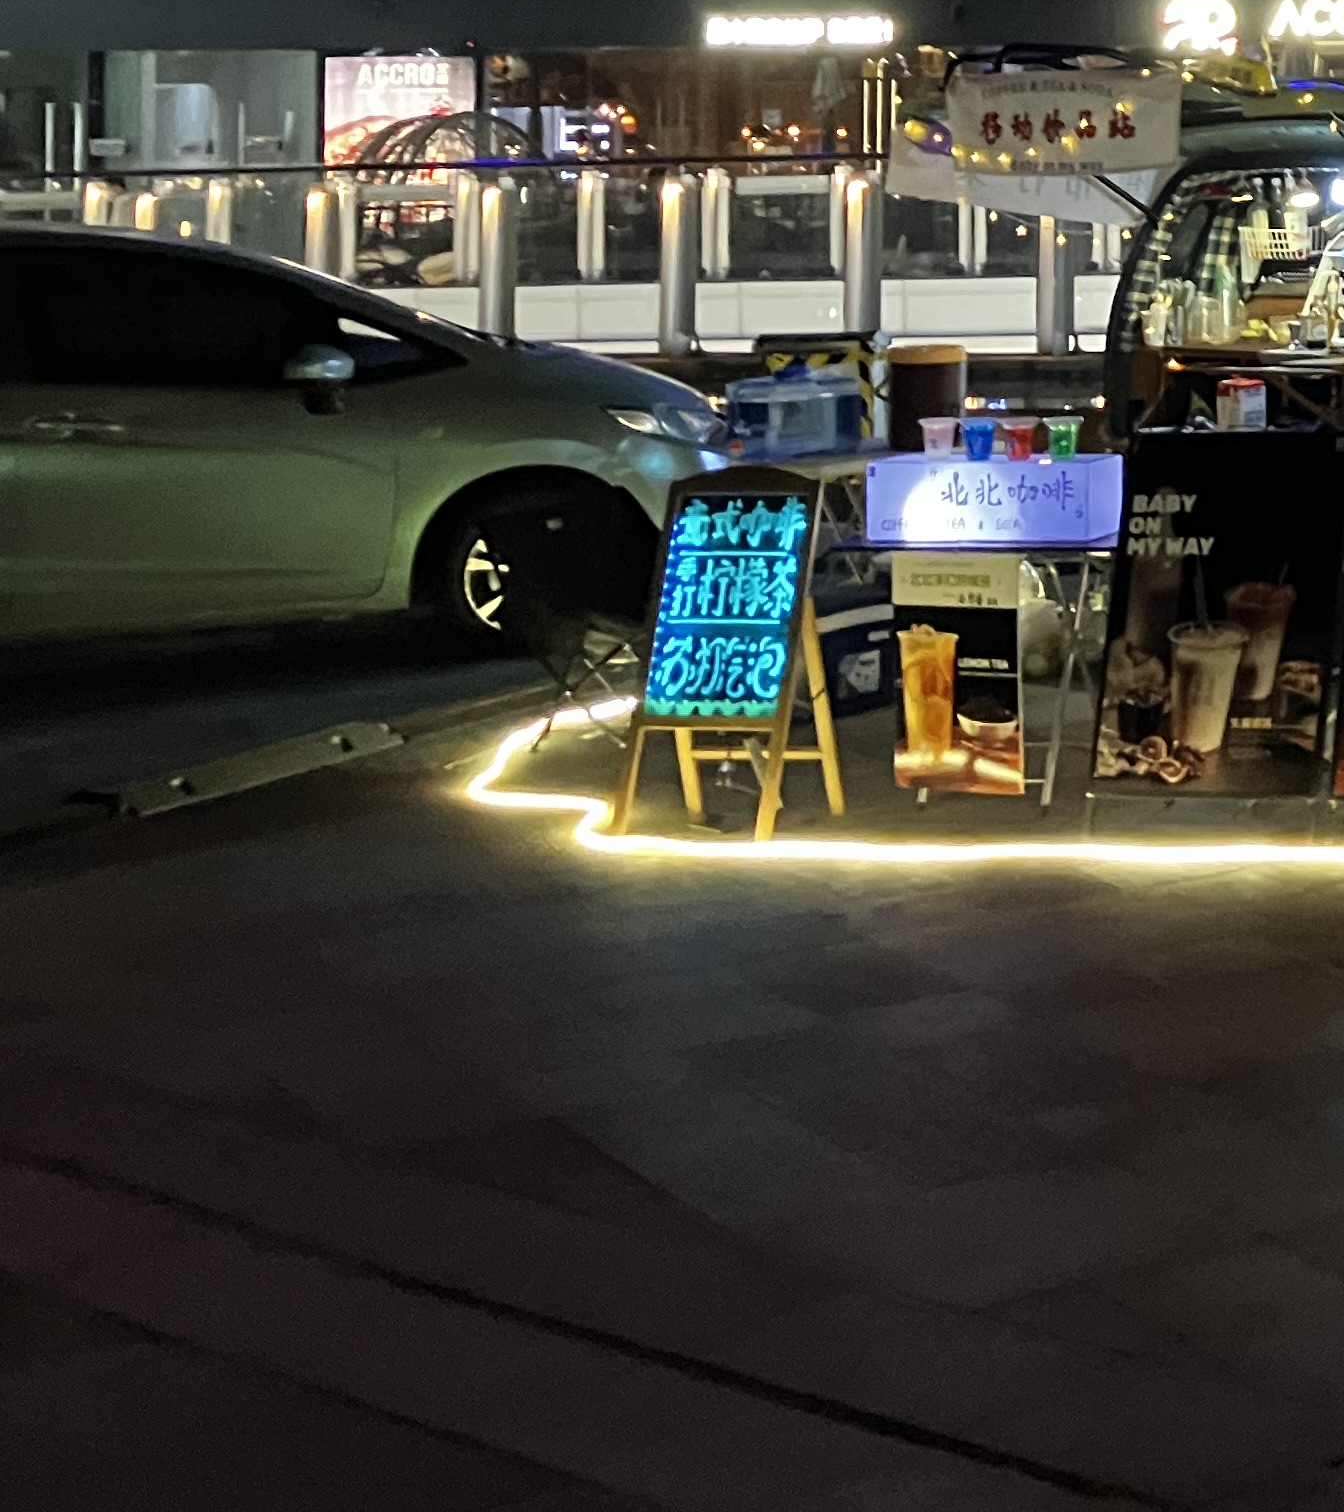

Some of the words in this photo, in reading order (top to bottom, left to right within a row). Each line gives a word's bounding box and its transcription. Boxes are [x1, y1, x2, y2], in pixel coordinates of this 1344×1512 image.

[358, 63, 435, 85] ACCRO
[941, 470, 1076, 511] 北北咖啡
[1132, 494, 1197, 514] BABY
[1129, 516, 1161, 536] ON
[1126, 537, 1161, 556] MY
[1165, 537, 1215, 556] WAY
